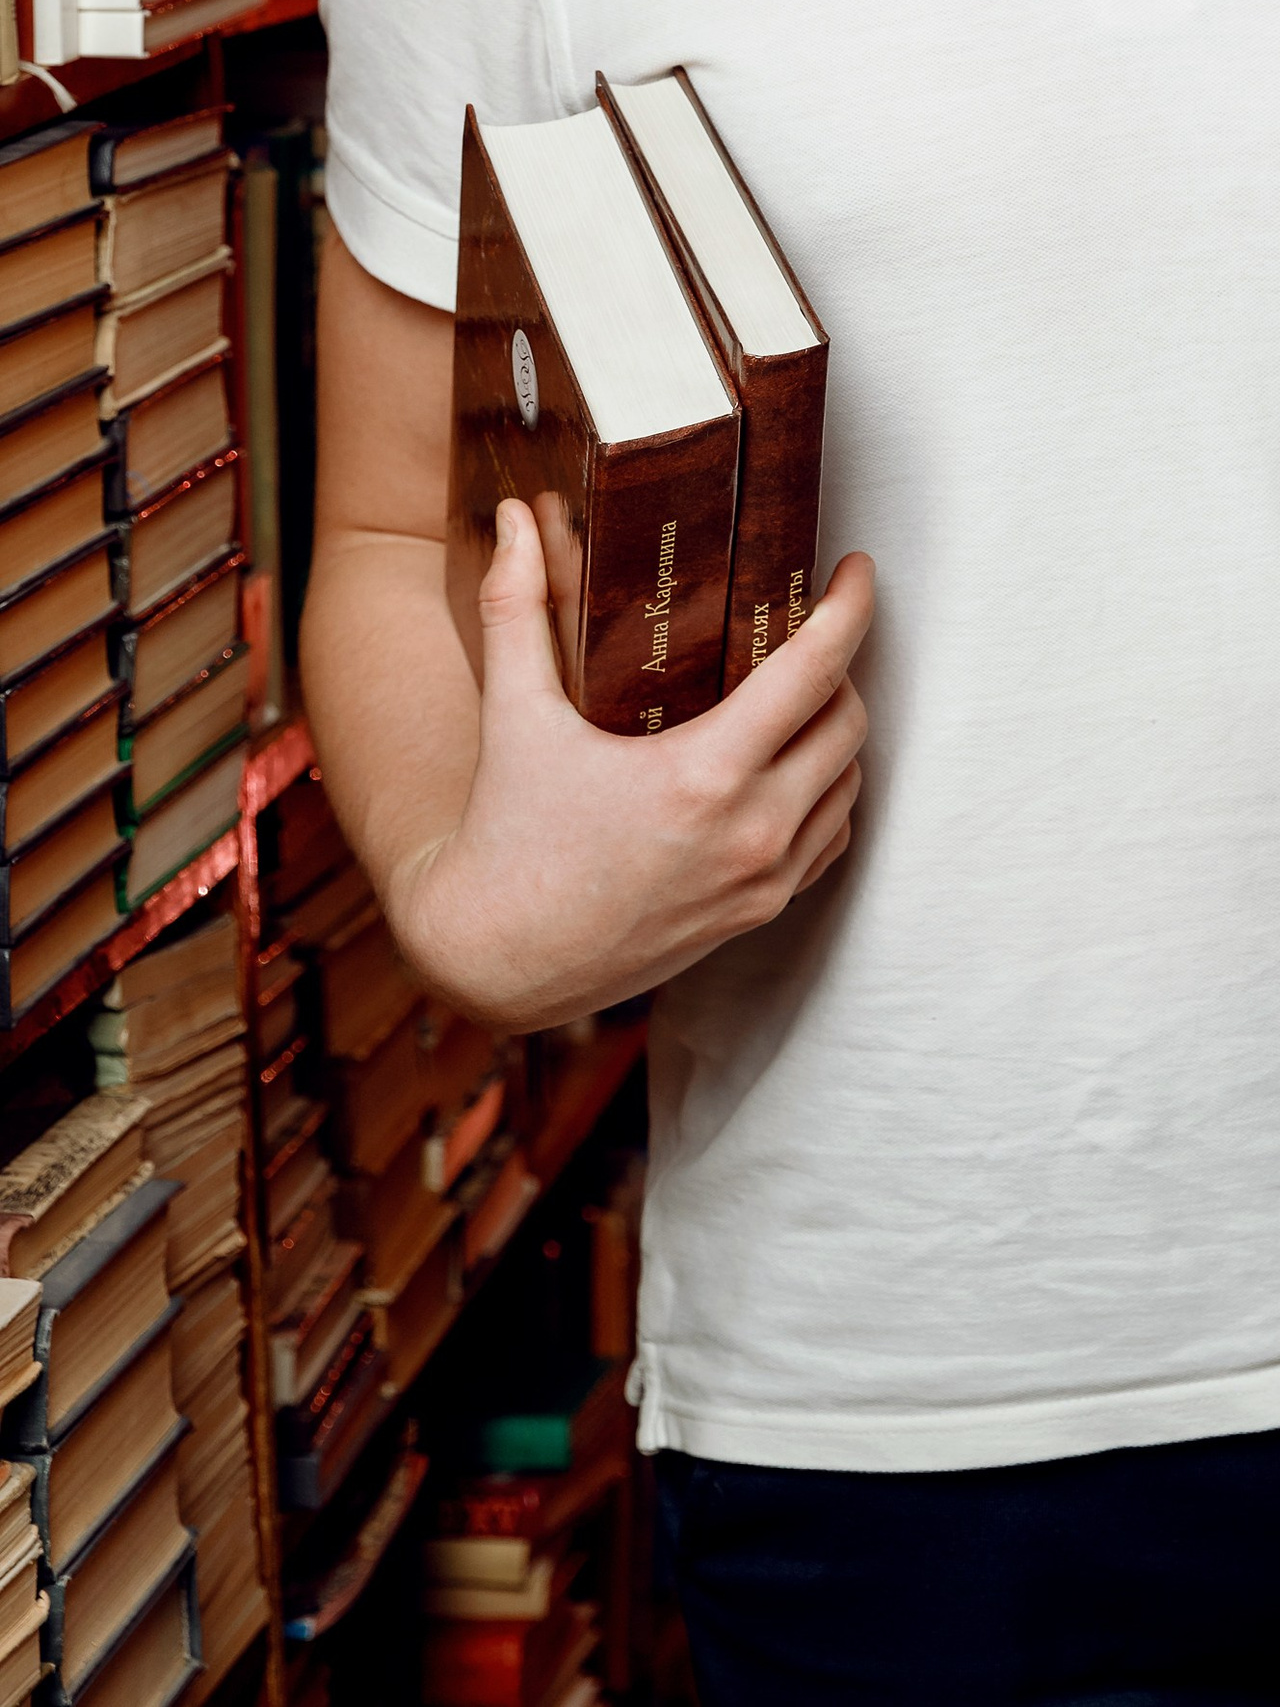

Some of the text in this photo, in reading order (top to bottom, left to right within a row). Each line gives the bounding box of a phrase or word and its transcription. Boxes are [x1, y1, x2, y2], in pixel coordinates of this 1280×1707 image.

[645, 520, 678, 619] Каренина
[641, 620, 669, 673] Анна
[751, 602, 770, 670] ателях
